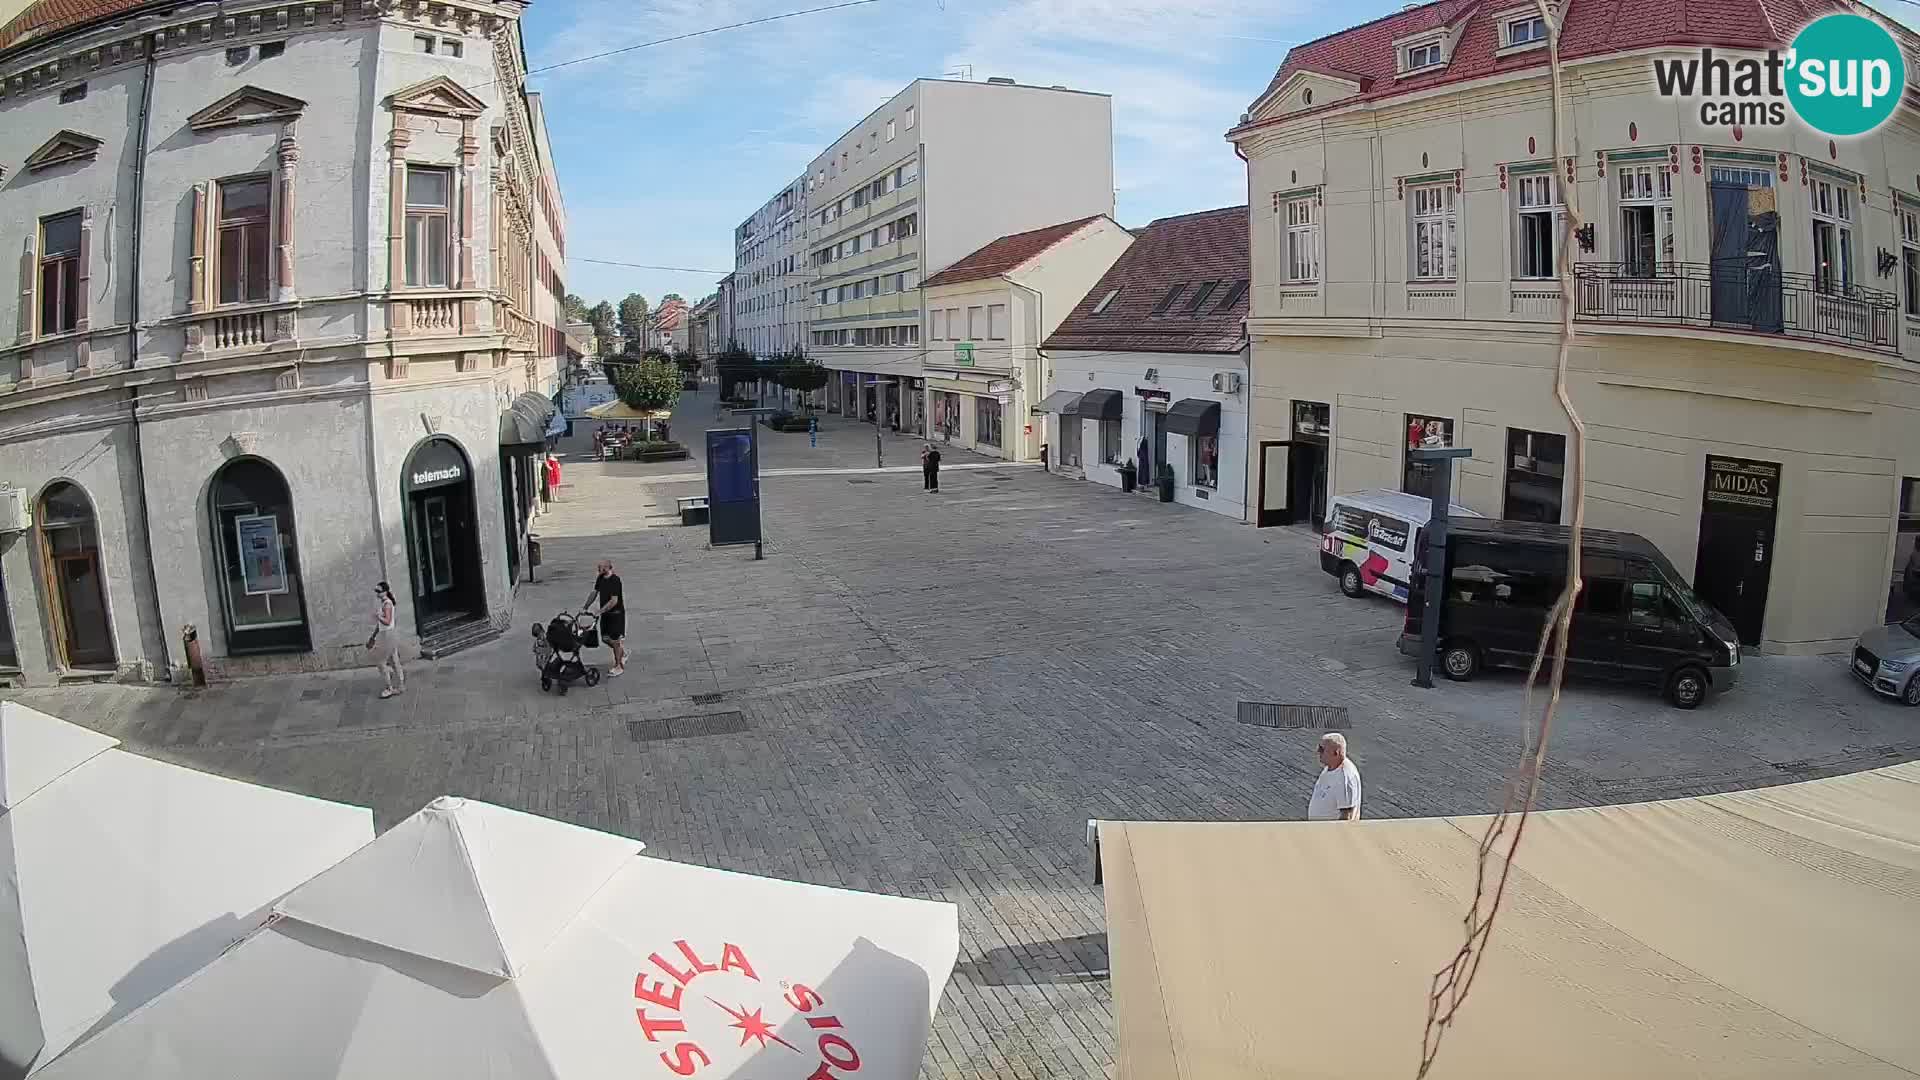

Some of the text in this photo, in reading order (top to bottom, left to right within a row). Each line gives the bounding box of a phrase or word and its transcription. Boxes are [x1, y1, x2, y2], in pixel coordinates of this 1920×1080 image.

[413, 465, 460, 485] telemach
[1715, 473, 1769, 495] MIDAS
[634, 939, 760, 1076] STELLA
